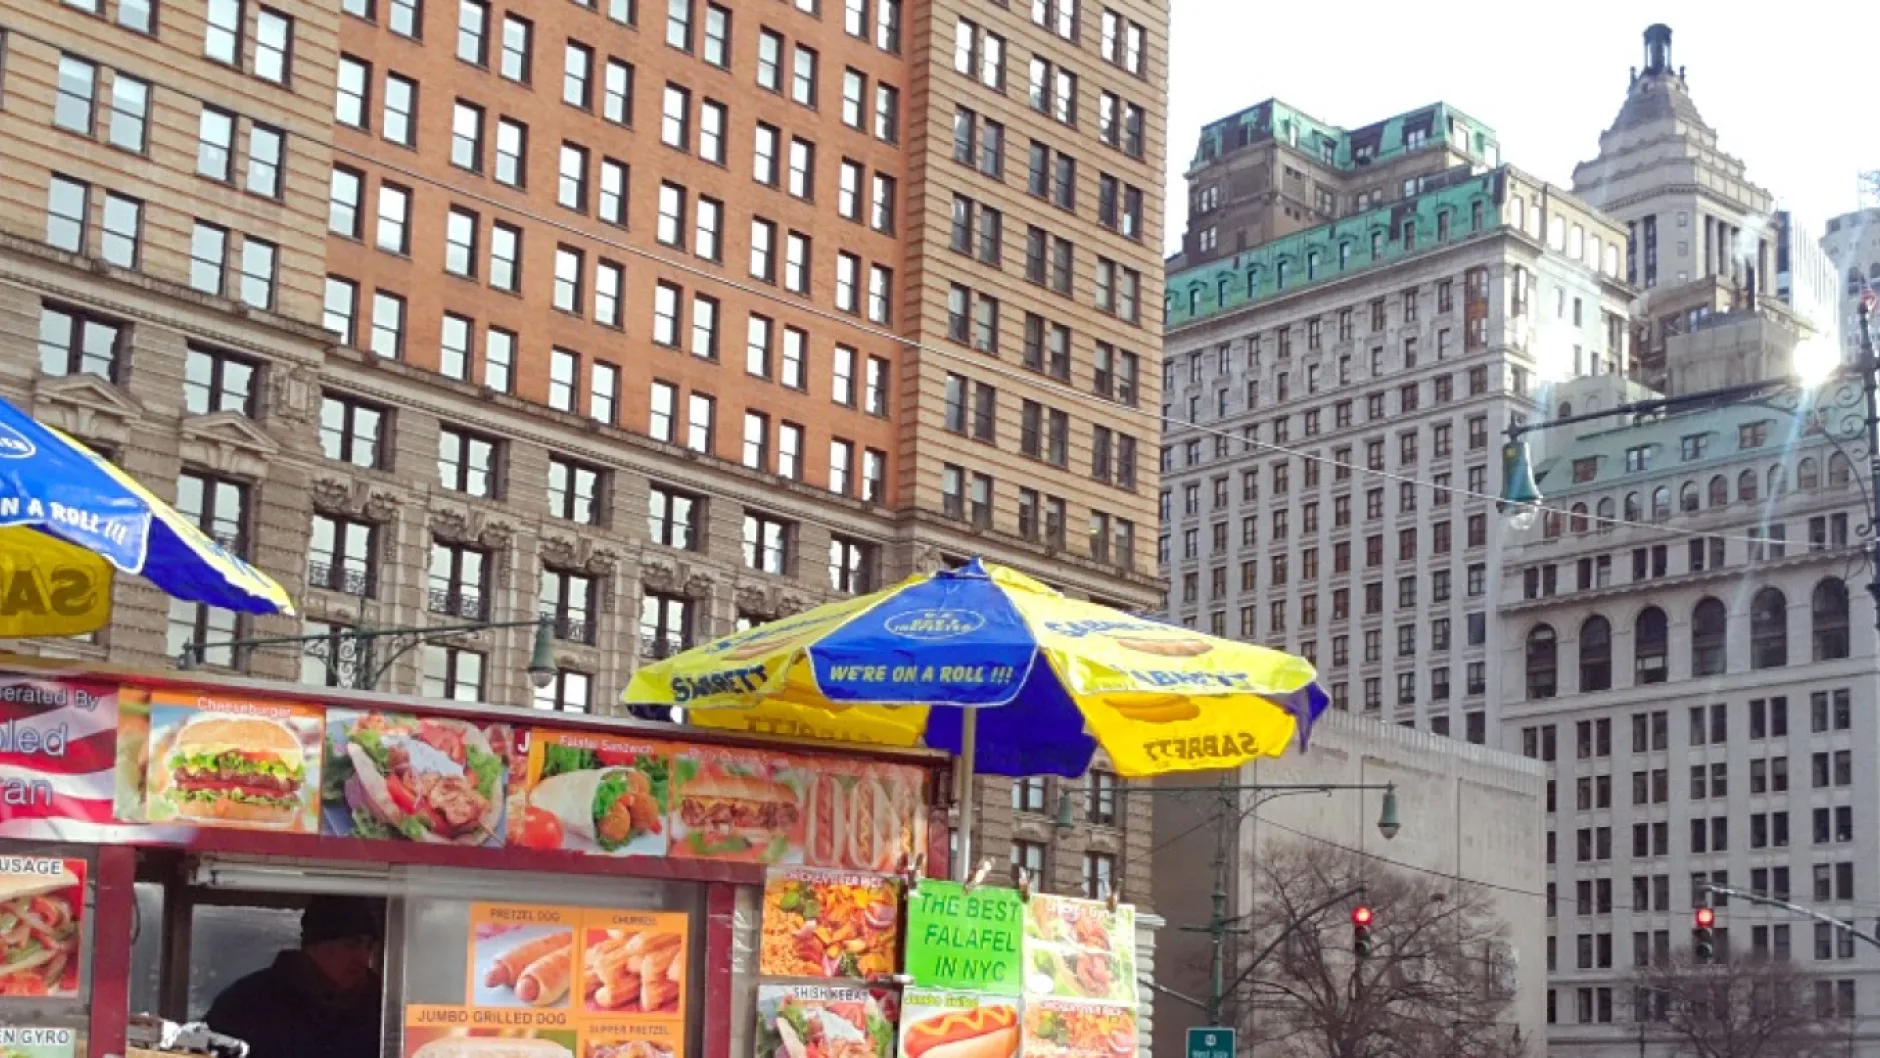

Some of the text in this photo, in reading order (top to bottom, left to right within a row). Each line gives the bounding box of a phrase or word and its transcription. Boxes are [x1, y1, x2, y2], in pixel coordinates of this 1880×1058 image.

[27, 497, 44, 518] A
[49, 502, 100, 533] ROLL
[830, 664, 888, 683] WE'RE
[892, 664, 918, 683] ON
[921, 665, 934, 683] A
[940, 664, 985, 684] ROLL
[0, 686, 99, 712] erated By
[0, 717, 68, 758] led
[0, 776, 53, 808] an
[489, 907, 561, 922] PRETZEL DOG
[921, 892, 1020, 922] THE BEST
[924, 923, 1016, 953] FALAFEL
[935, 955, 1007, 982] IN NYC
[793, 986, 828, 999] SHISH
[417, 1010, 567, 1026] JUMBO GRILLED DOG
[0, 1028, 69, 1045] N GYRO
